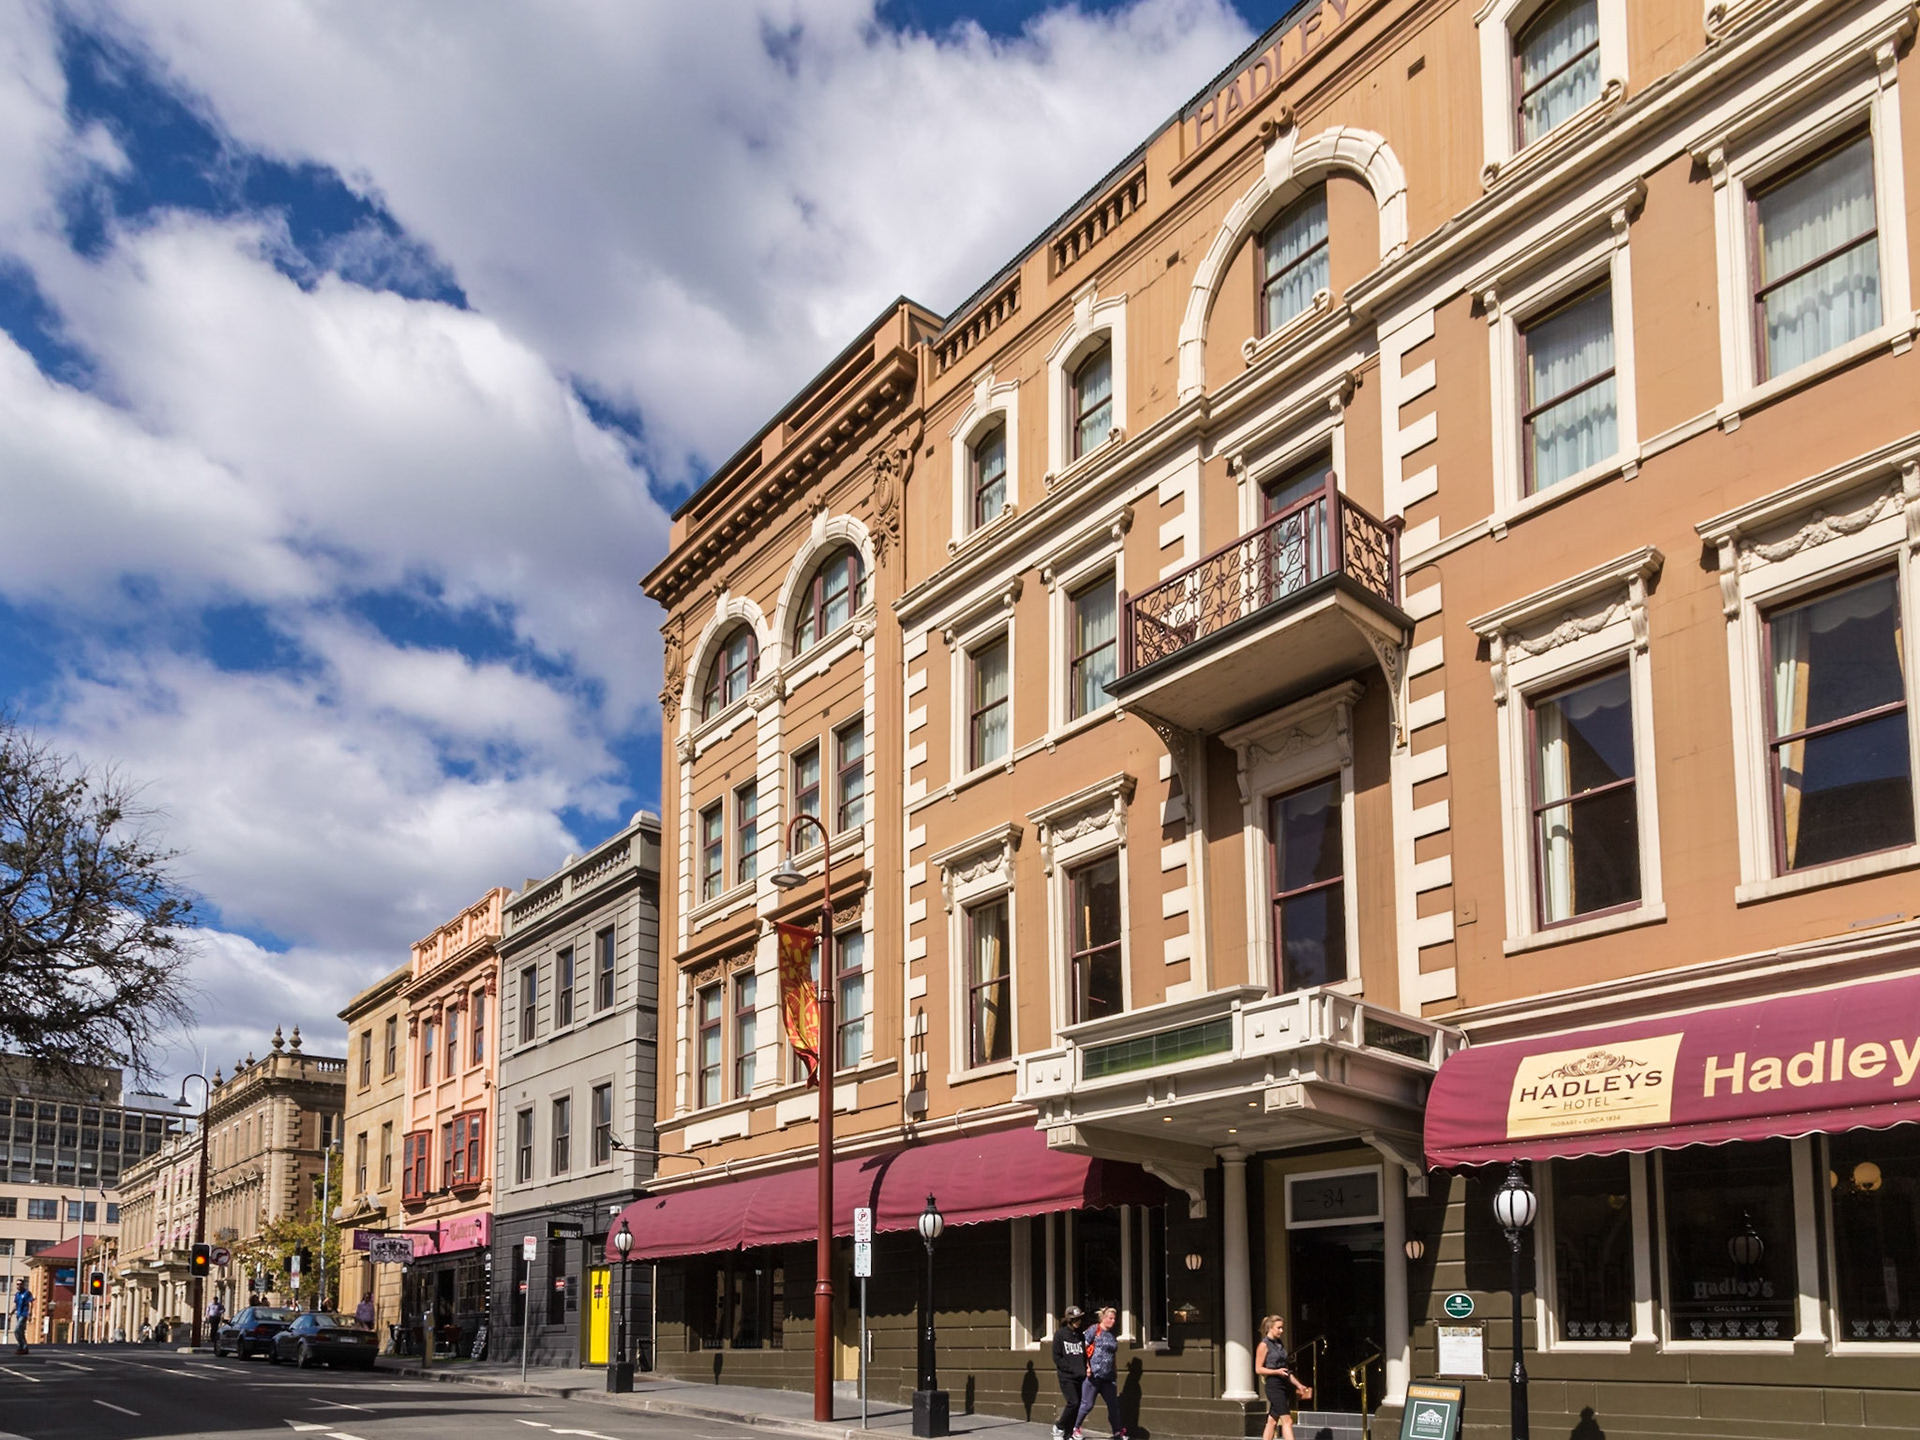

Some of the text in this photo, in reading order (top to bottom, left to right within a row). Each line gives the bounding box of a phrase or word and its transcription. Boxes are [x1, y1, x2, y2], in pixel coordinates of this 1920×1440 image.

[1703, 1036, 1920, 1098] Hadley
[1519, 1070, 1663, 1102] HADLEYS
[1563, 1096, 1610, 1111] HOTEL
[1550, 1119, 1577, 1127] HOBART
[1583, 1116, 1604, 1124] CIRCA
[373, 1249, 412, 1257] VICTORIA
[1413, 1388, 1438, 1397] GALLERY
